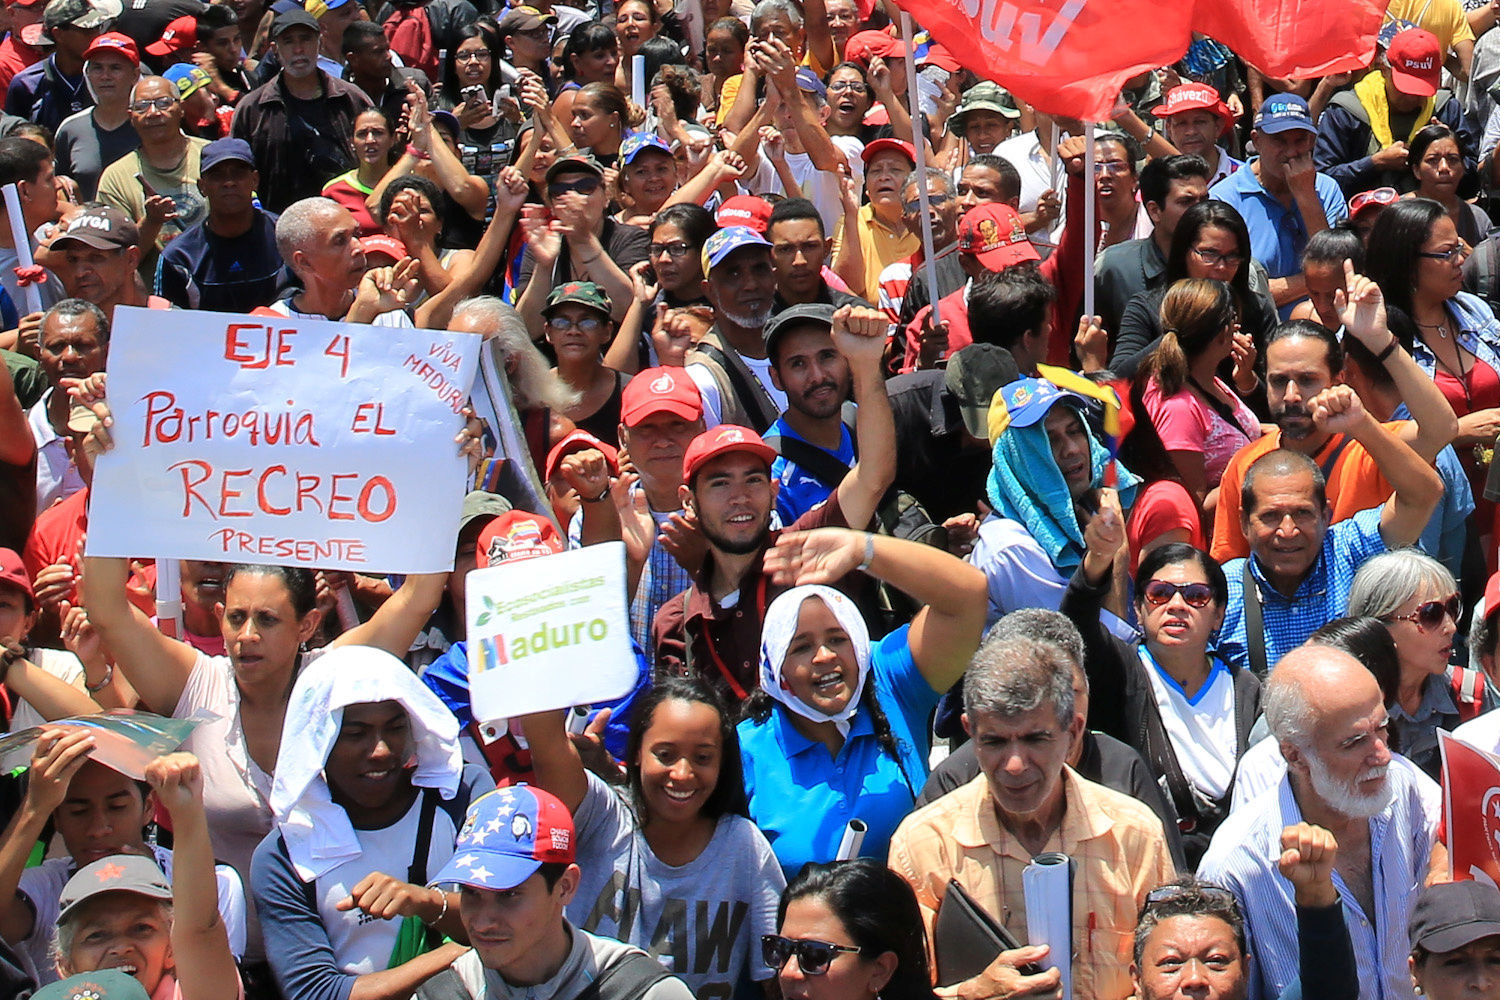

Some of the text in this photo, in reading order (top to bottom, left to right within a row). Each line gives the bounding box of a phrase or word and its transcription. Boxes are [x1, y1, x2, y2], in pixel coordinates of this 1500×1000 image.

[225, 323, 351, 378] EJE 4
[141, 391, 397, 448] Parroquia EL
[166, 459, 398, 523] RECREO
[207, 528, 369, 562] PRESENTE
[477, 617, 609, 674] Maduro
